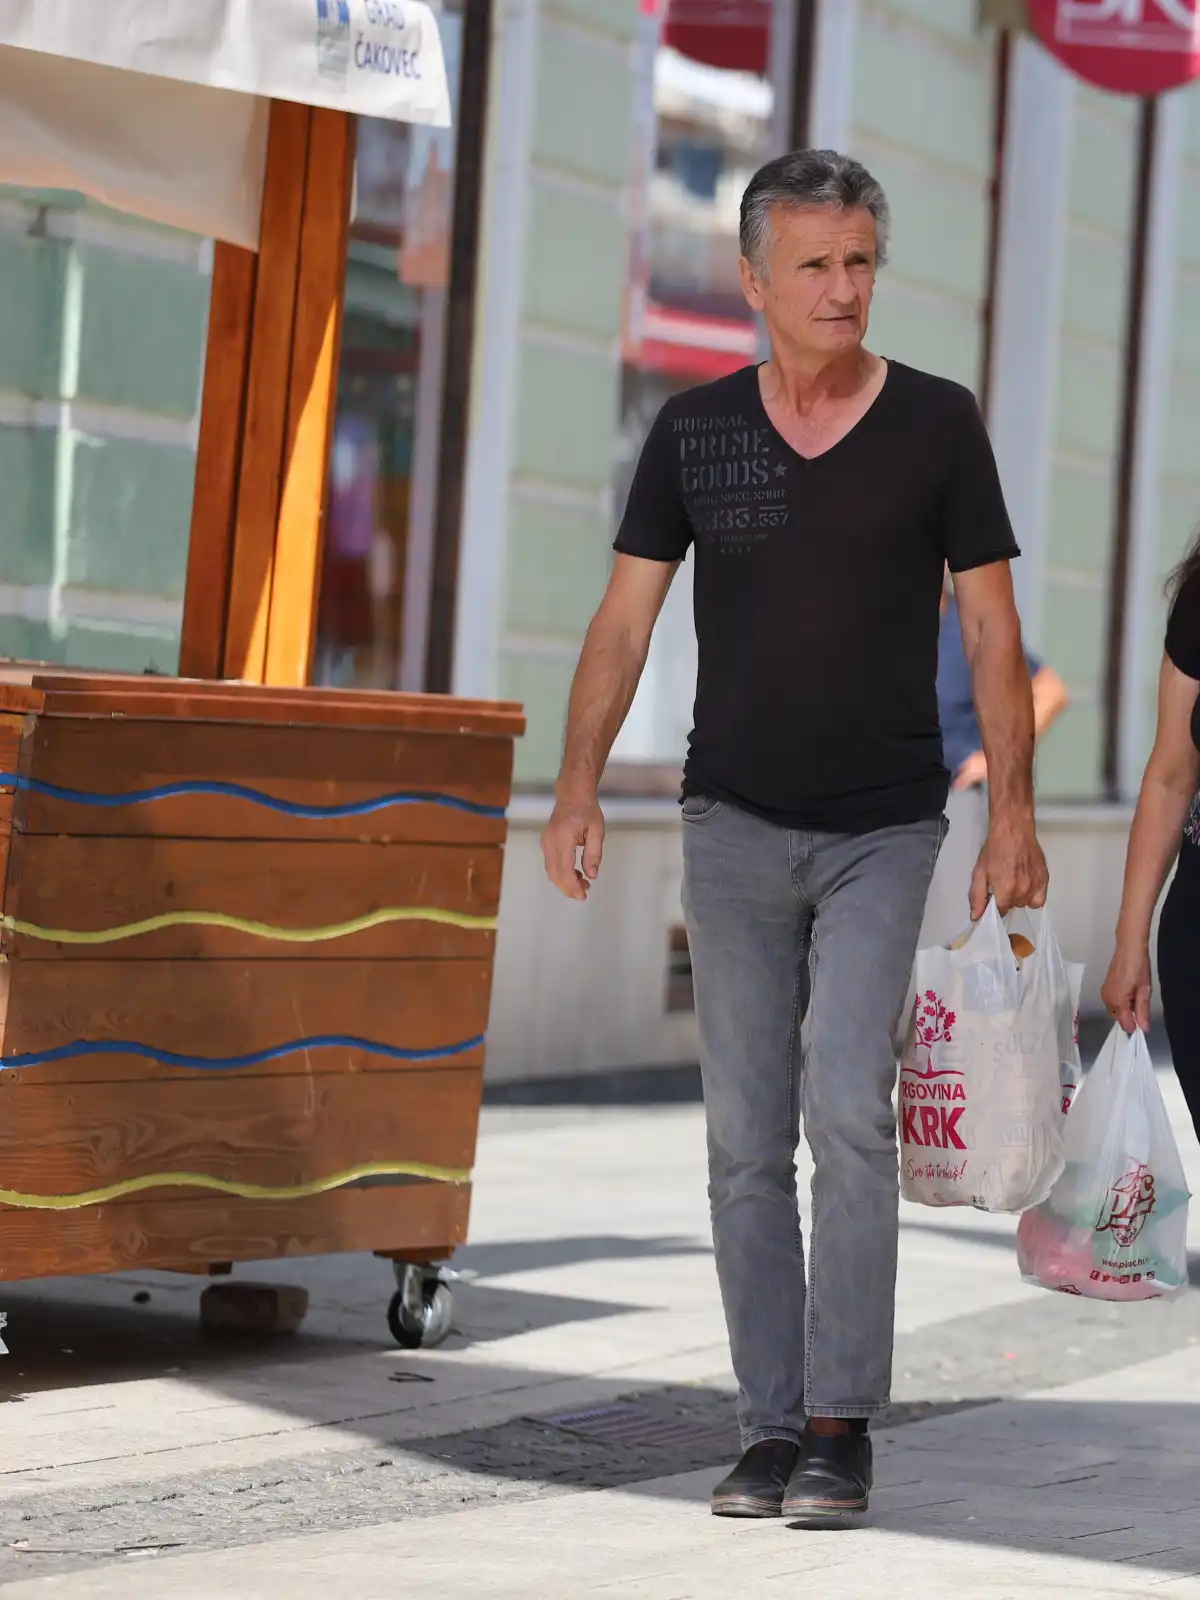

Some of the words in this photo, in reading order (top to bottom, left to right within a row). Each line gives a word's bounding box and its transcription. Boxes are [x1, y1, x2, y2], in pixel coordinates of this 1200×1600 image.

[364, 0, 405, 30] GRAD
[355, 31, 421, 79] ČAKOVEC
[681, 428, 769, 461] PRIME
[682, 459, 769, 493] GOODS
[902, 1081, 967, 1100] RGOVINA
[902, 1104, 968, 1150] KRK
